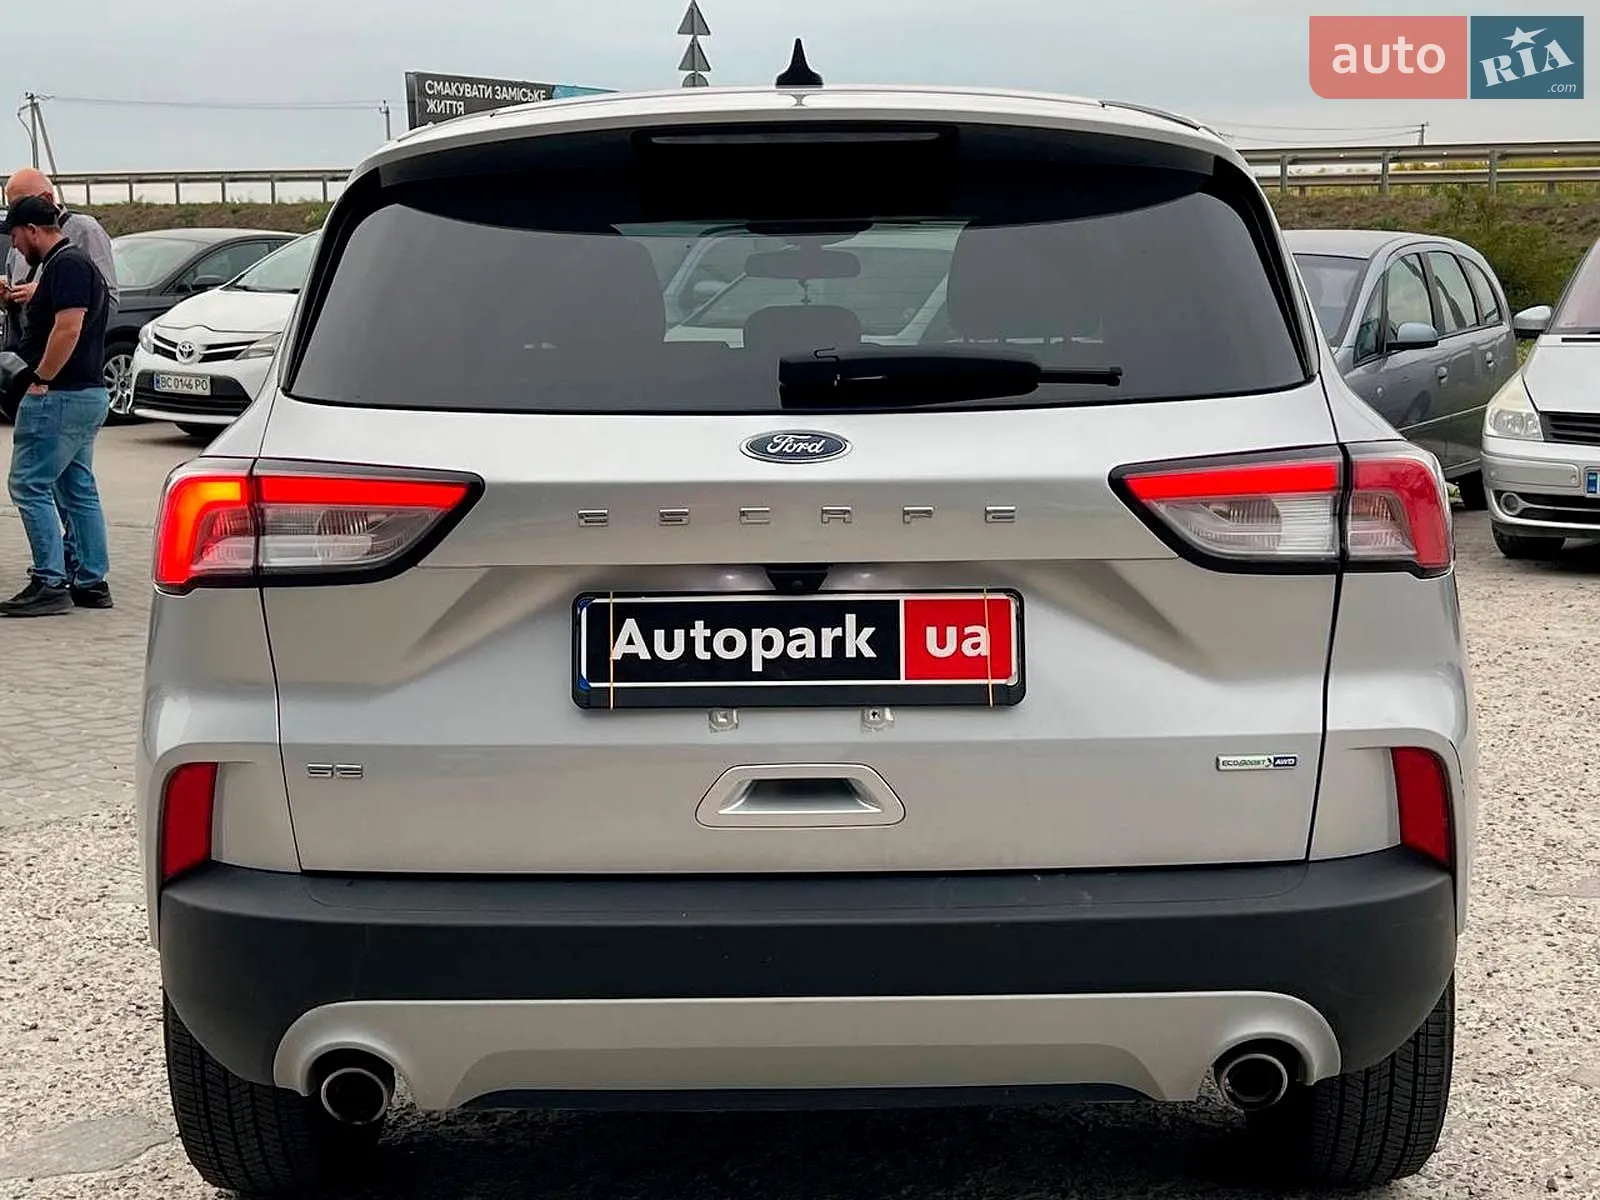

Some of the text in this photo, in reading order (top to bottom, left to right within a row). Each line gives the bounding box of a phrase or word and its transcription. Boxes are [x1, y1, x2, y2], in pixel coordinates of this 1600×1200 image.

[424, 80, 546, 102] СМАКУВАТИ ЗАМІСЬКЕ
[426, 99, 465, 115] ЖИТТЯ
[766, 434, 826, 454] Ford
[577, 505, 1017, 528] ESCAPE
[609, 613, 991, 672] Autopark ua
[307, 763, 363, 779] SE
